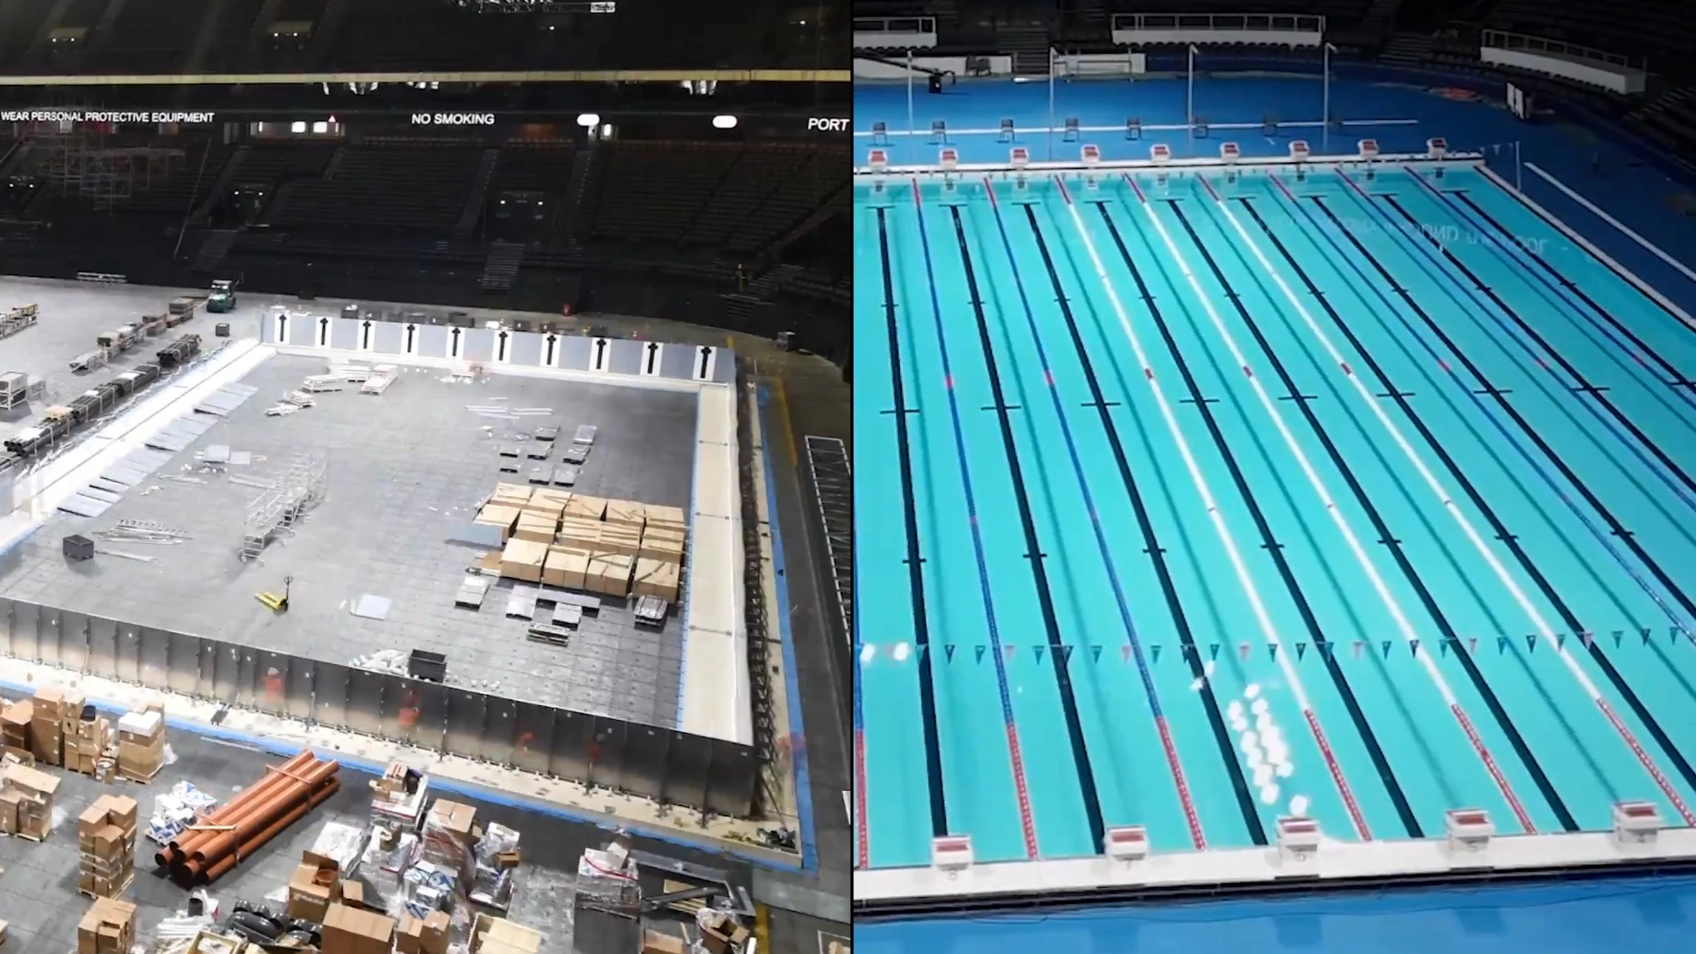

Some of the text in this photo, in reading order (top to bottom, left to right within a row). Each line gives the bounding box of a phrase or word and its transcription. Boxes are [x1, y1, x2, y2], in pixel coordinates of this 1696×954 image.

[1, 111, 215, 123] WEAR PERSONAL PROTECTIVE EQUIPMENT
[411, 113, 495, 125] NO SMOKING
[807, 117, 850, 131] PORT
